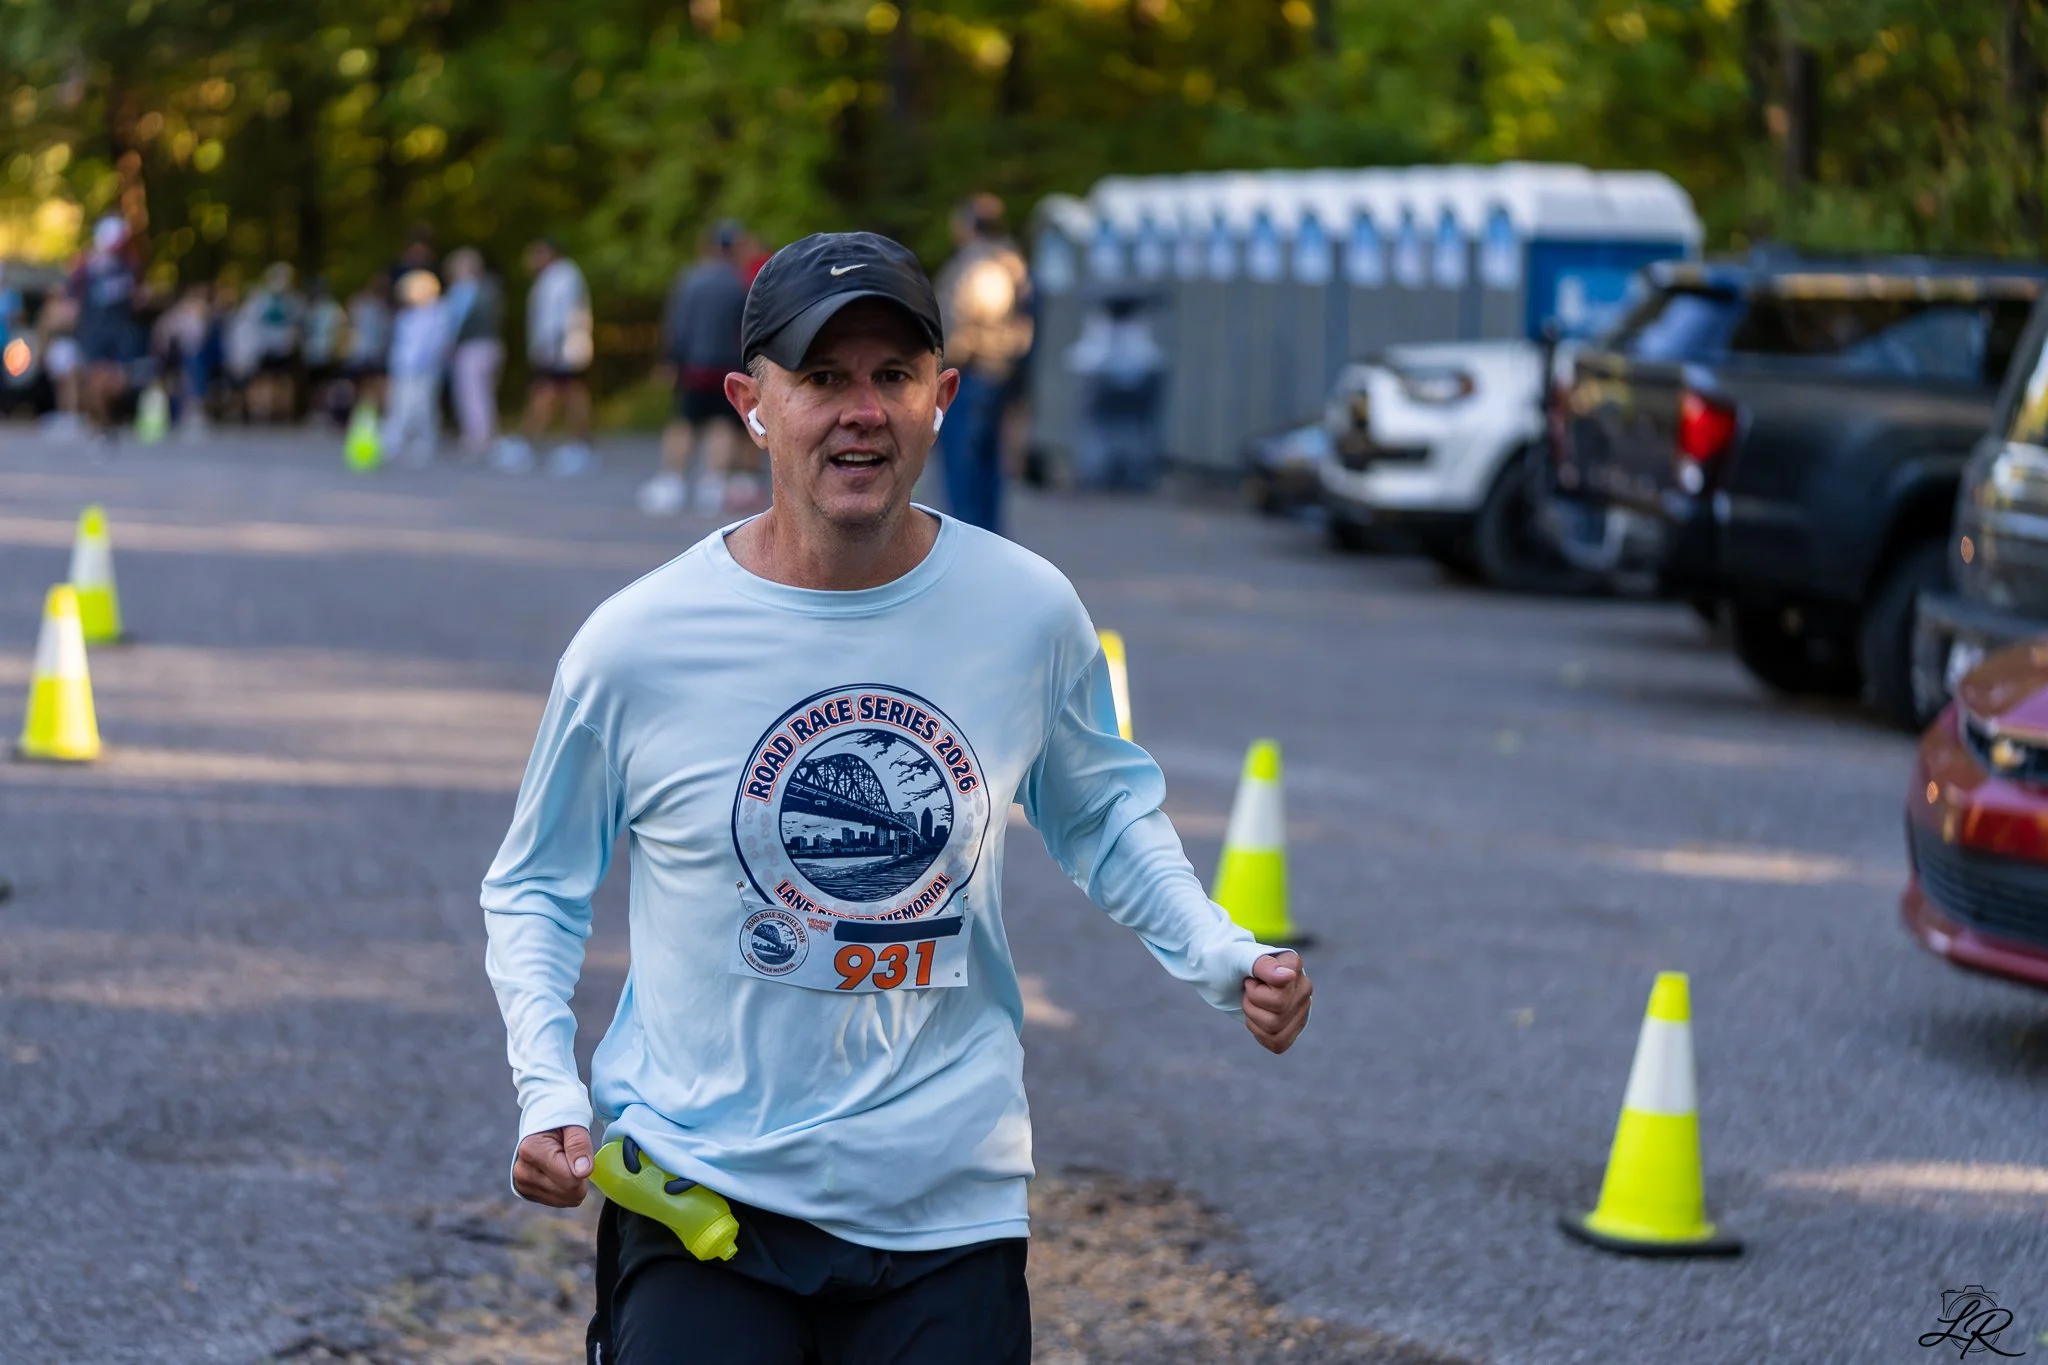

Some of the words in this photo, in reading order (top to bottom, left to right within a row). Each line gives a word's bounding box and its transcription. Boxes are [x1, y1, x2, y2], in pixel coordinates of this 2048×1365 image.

[748, 734, 795, 801] ROAD
[789, 696, 854, 743] RACE
[858, 696, 939, 742] SERIES
[935, 734, 978, 793] 2026
[746, 916, 760, 931] ROAD
[760, 911, 776, 920] RACE
[777, 912, 798, 928] SERIES
[795, 926, 806, 943] 2026
[833, 940, 937, 990] 931
